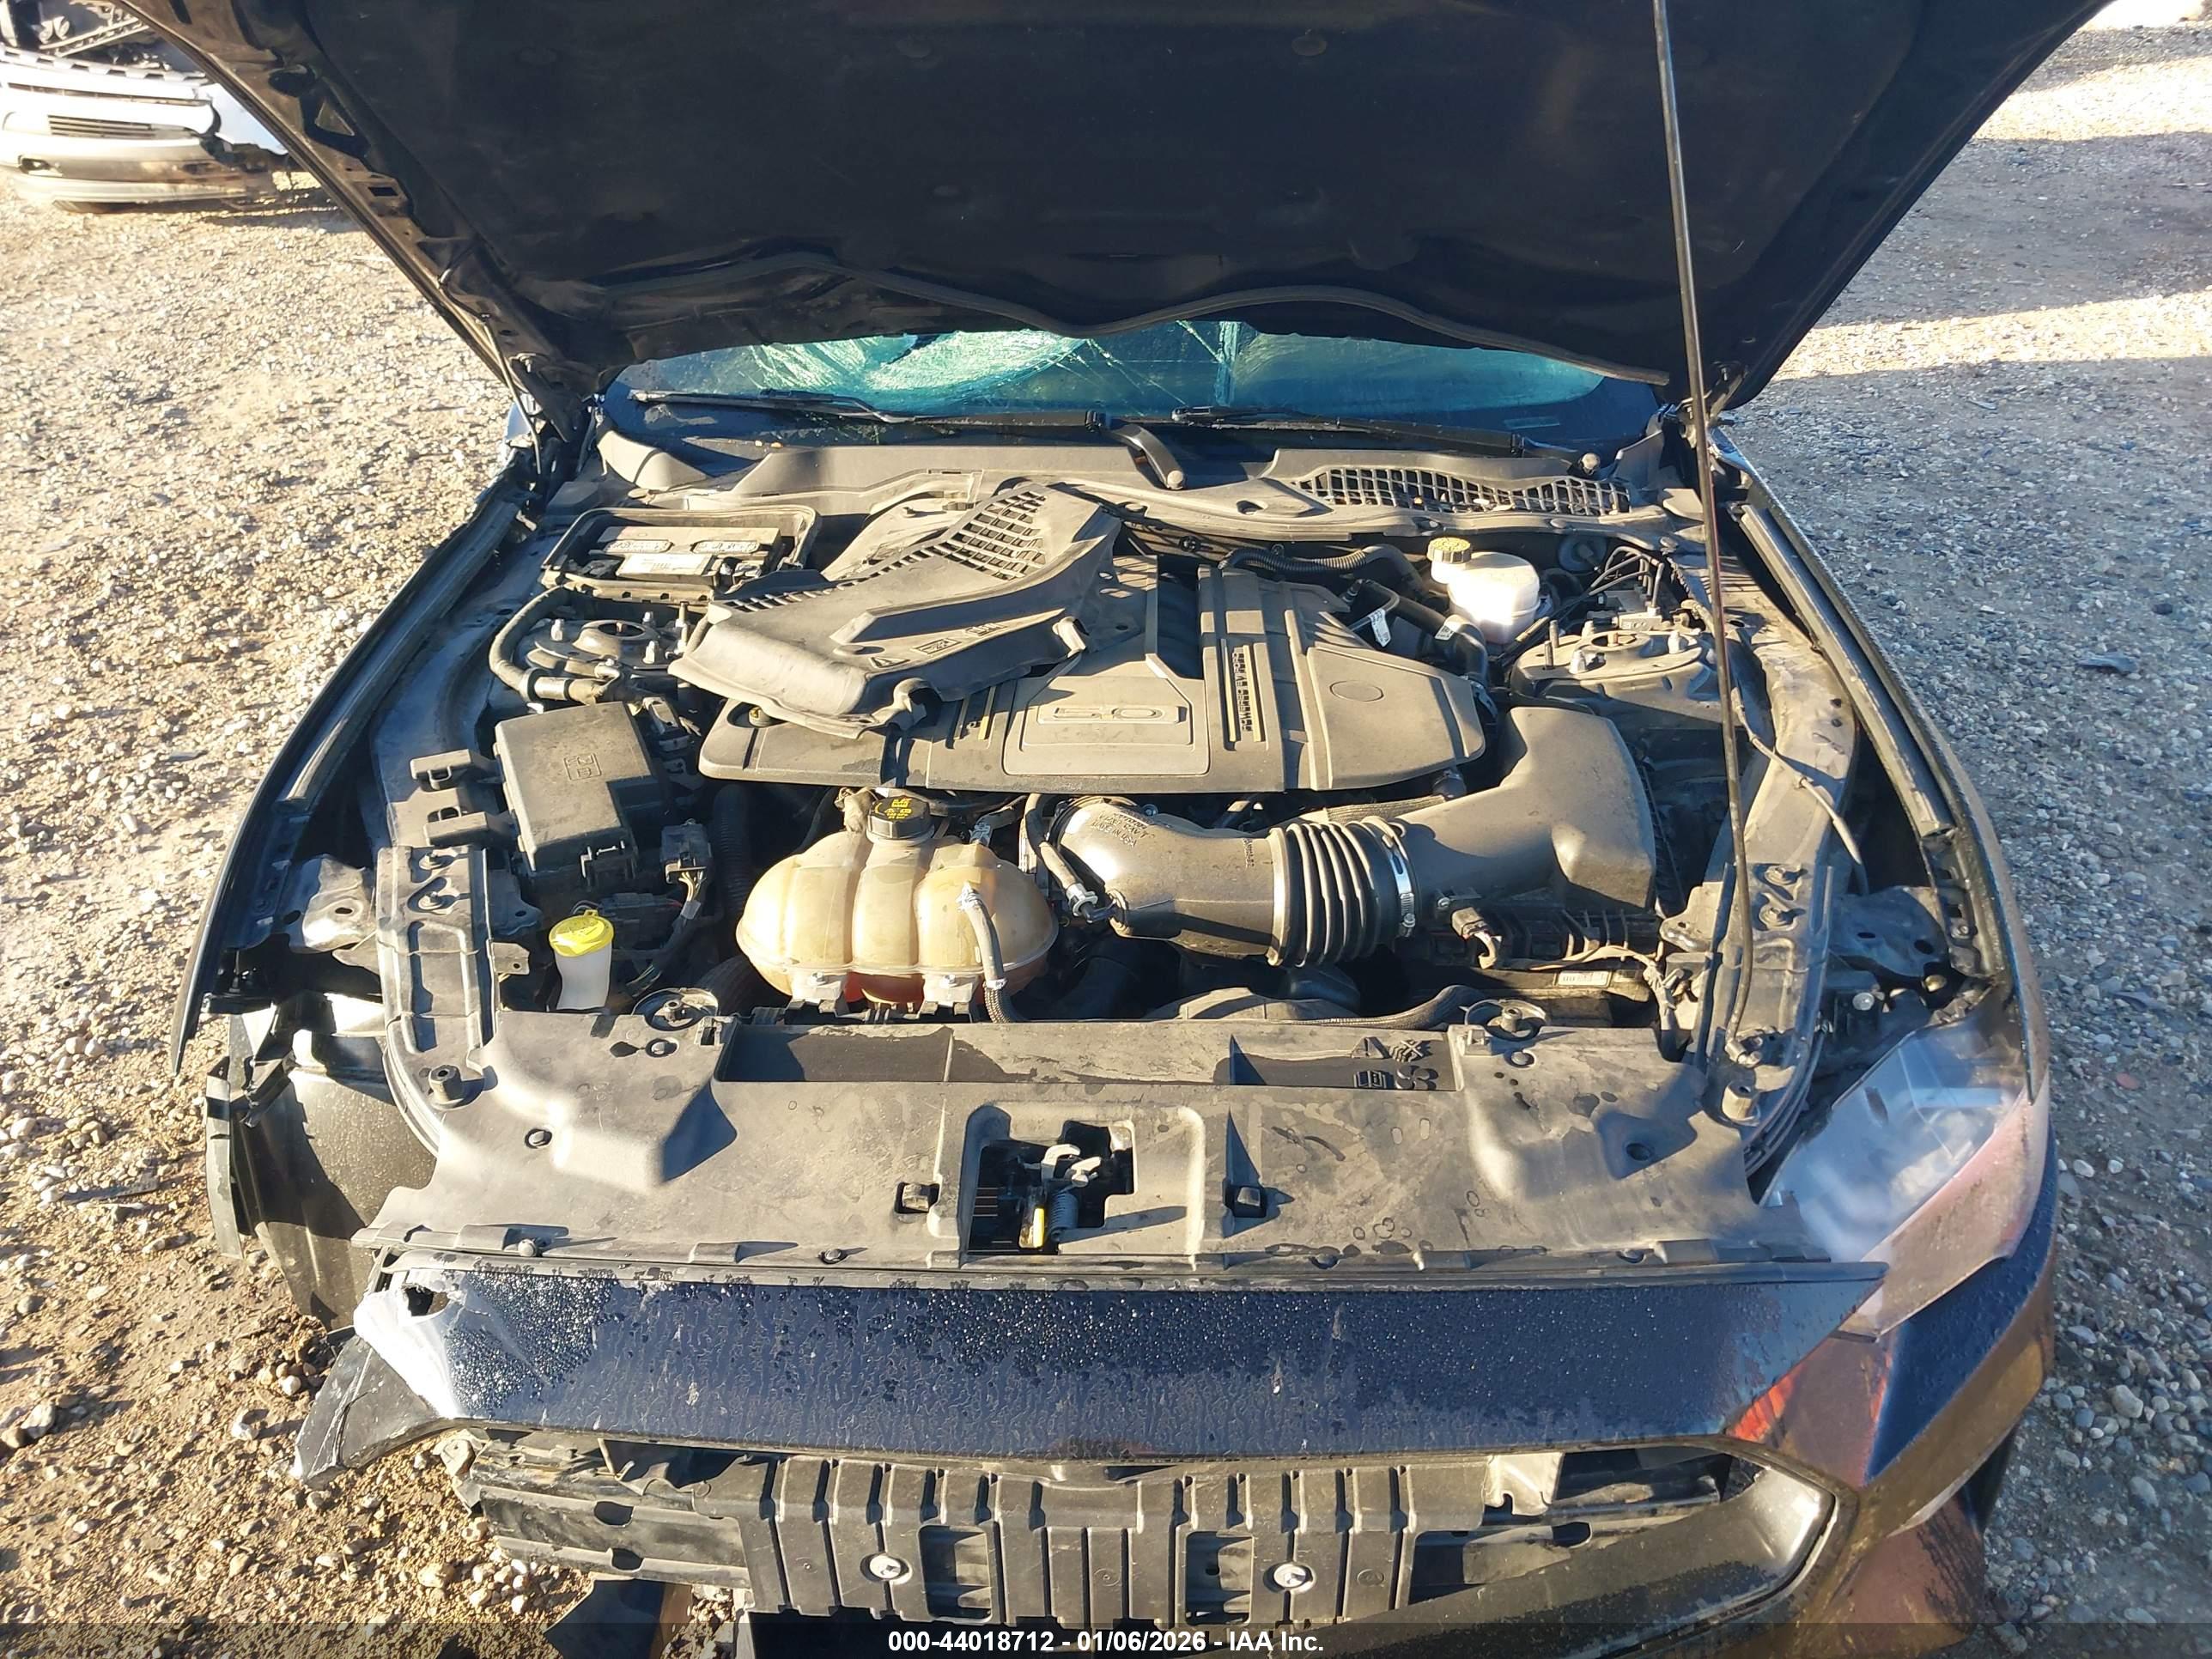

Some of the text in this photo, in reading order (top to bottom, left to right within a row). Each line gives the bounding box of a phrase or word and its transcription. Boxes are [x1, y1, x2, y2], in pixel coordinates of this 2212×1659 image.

[1053, 706, 1164, 721] 5.0
[1231, 653, 1253, 732] POWERED BY FORD
